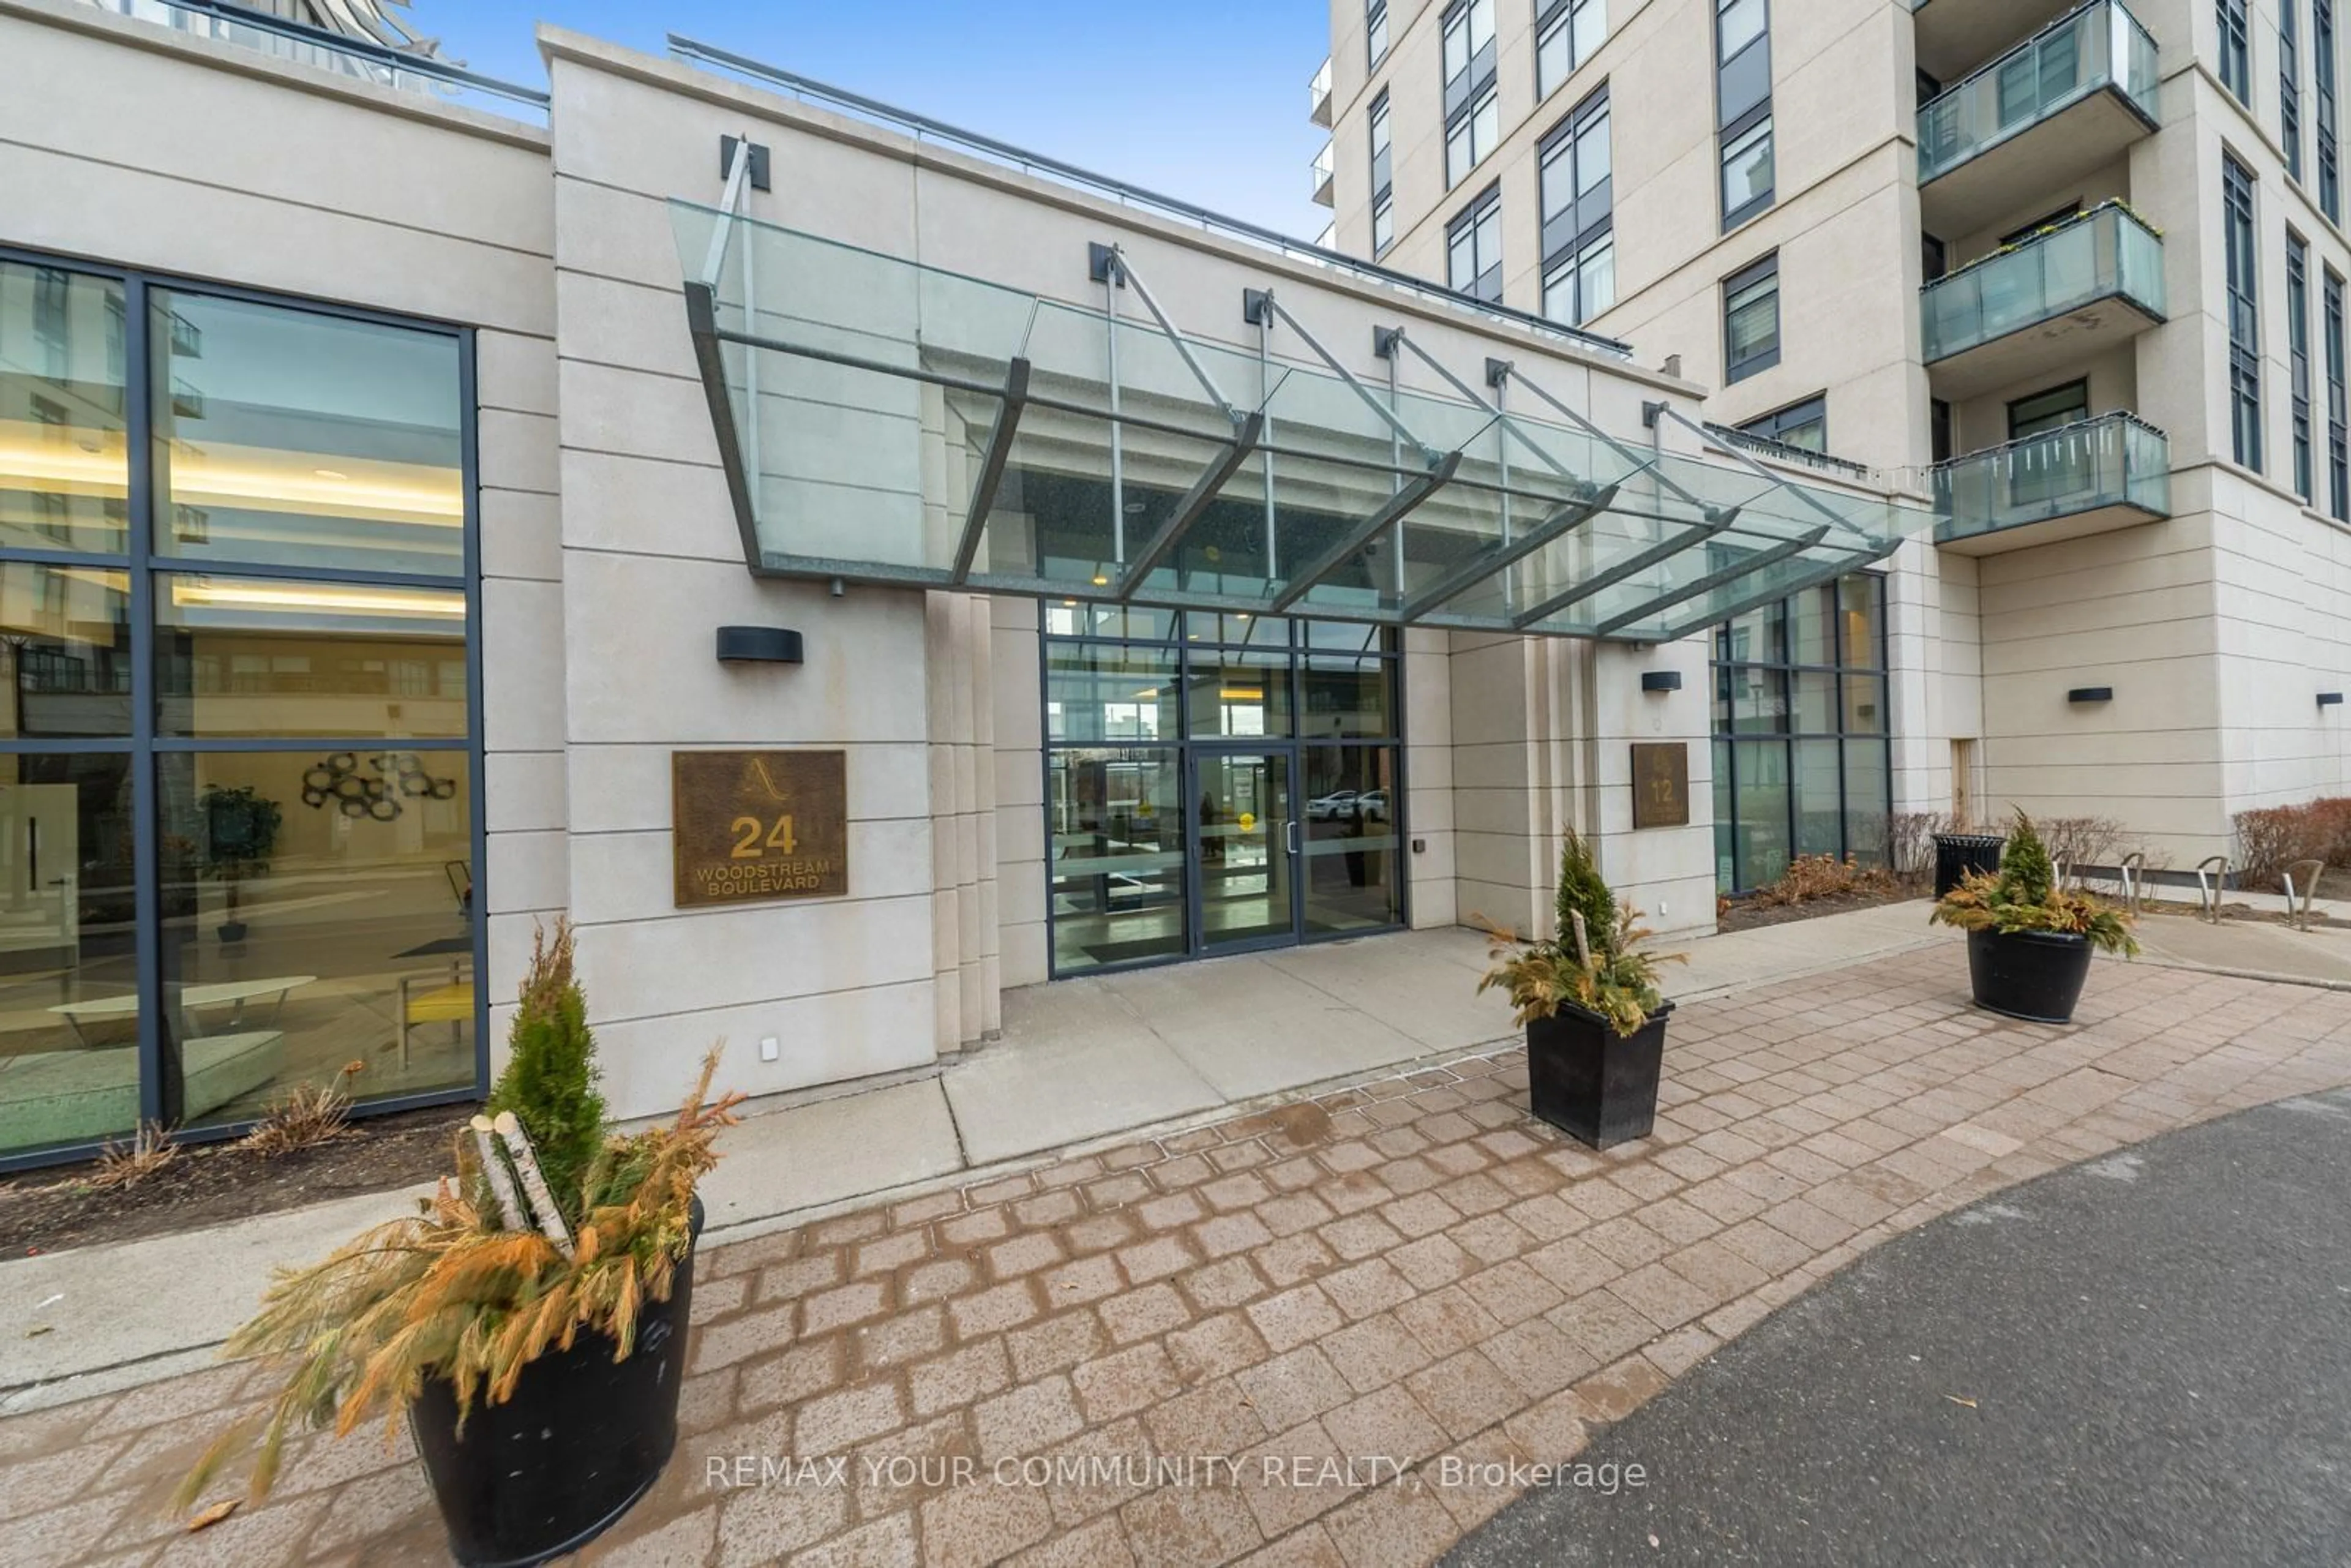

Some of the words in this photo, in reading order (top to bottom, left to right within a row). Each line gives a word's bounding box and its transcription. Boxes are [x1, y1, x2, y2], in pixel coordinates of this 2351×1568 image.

[1651, 779, 1673, 803] 12
[730, 815, 797, 858] 24
[696, 860, 830, 882] WOODSTREAM
[708, 875, 820, 896] BOULEVARD
